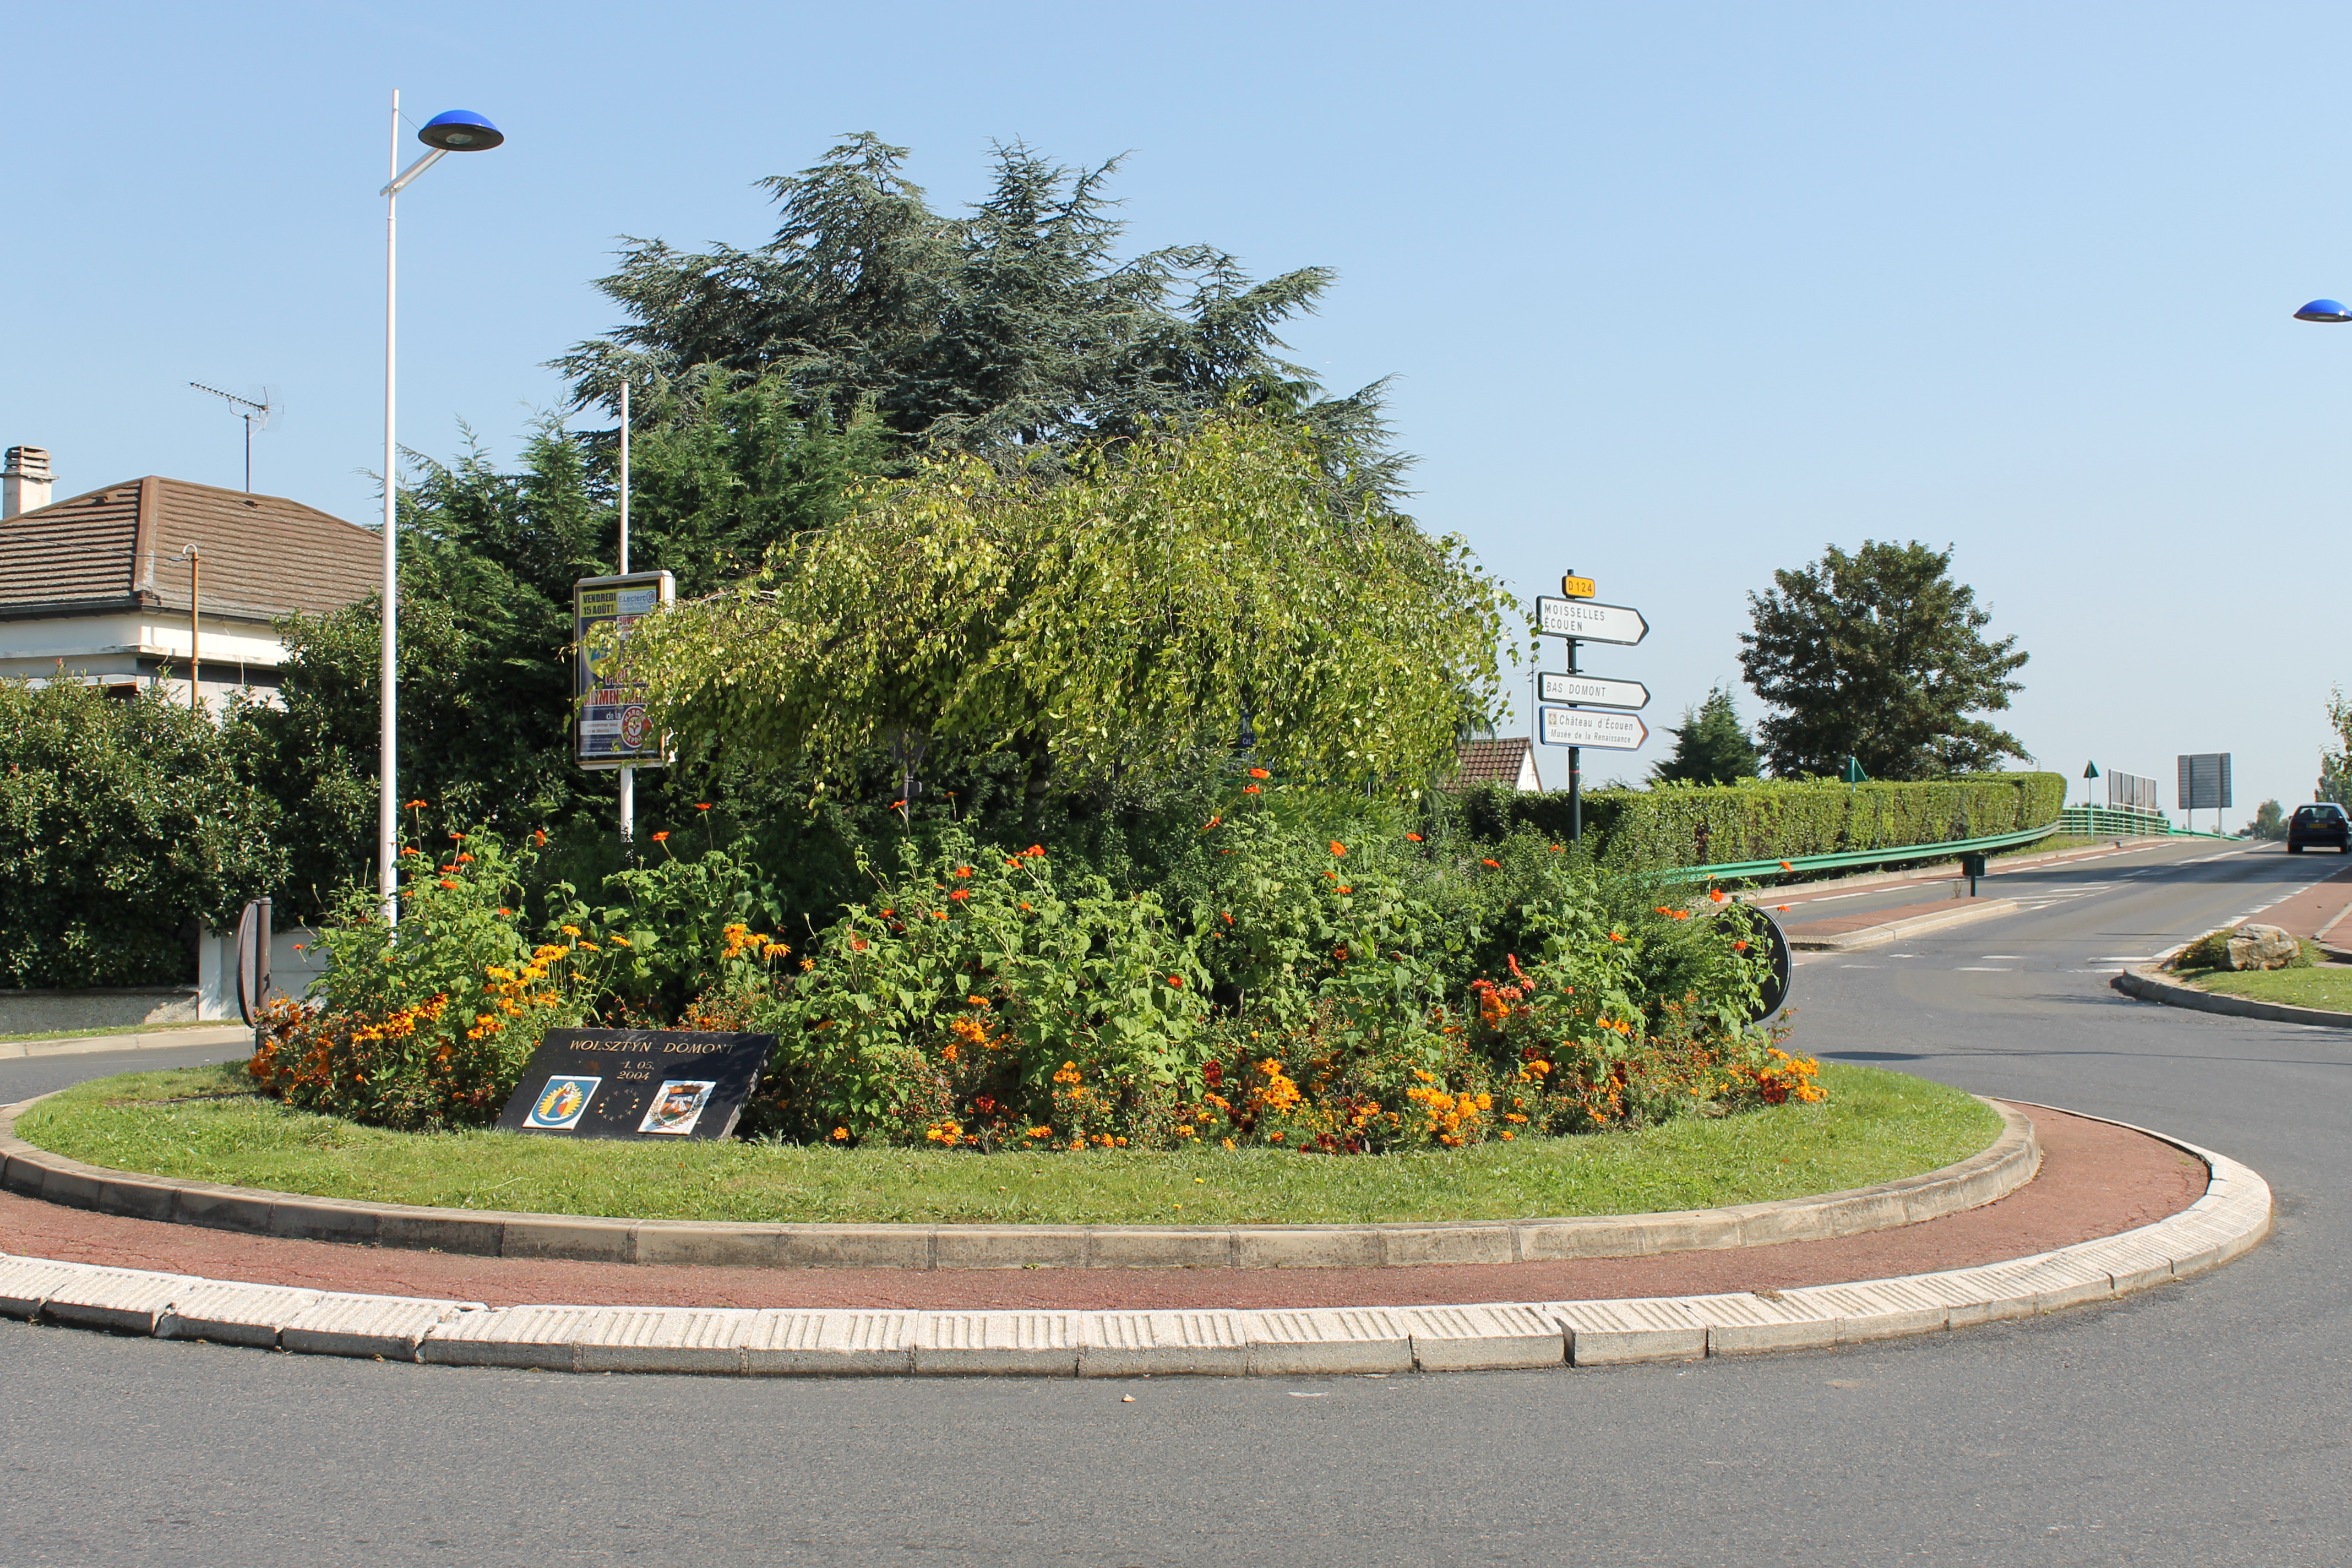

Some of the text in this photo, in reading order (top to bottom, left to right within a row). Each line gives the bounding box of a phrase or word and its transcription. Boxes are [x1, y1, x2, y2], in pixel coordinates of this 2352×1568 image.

[1569, 581, 1592, 593] D 124
[583, 592, 616, 603] VENDREDI
[583, 606, 591, 616] 15
[592, 603, 610, 614] AOÛT
[1544, 603, 1605, 621] MOISSELLES
[1544, 616, 1583, 632] ÉCOUEN
[1547, 682, 1606, 698] BAS DOMONT
[1559, 715, 1592, 728] Château
[1575, 731, 1582, 739] de
[1585, 732, 1591, 740] la
[1594, 732, 1631, 743] Renaissance
[569, 1040, 652, 1053] WOLSZTYN
[662, 1043, 736, 1055] DOMONT
[616, 1070, 650, 1080] 2004
